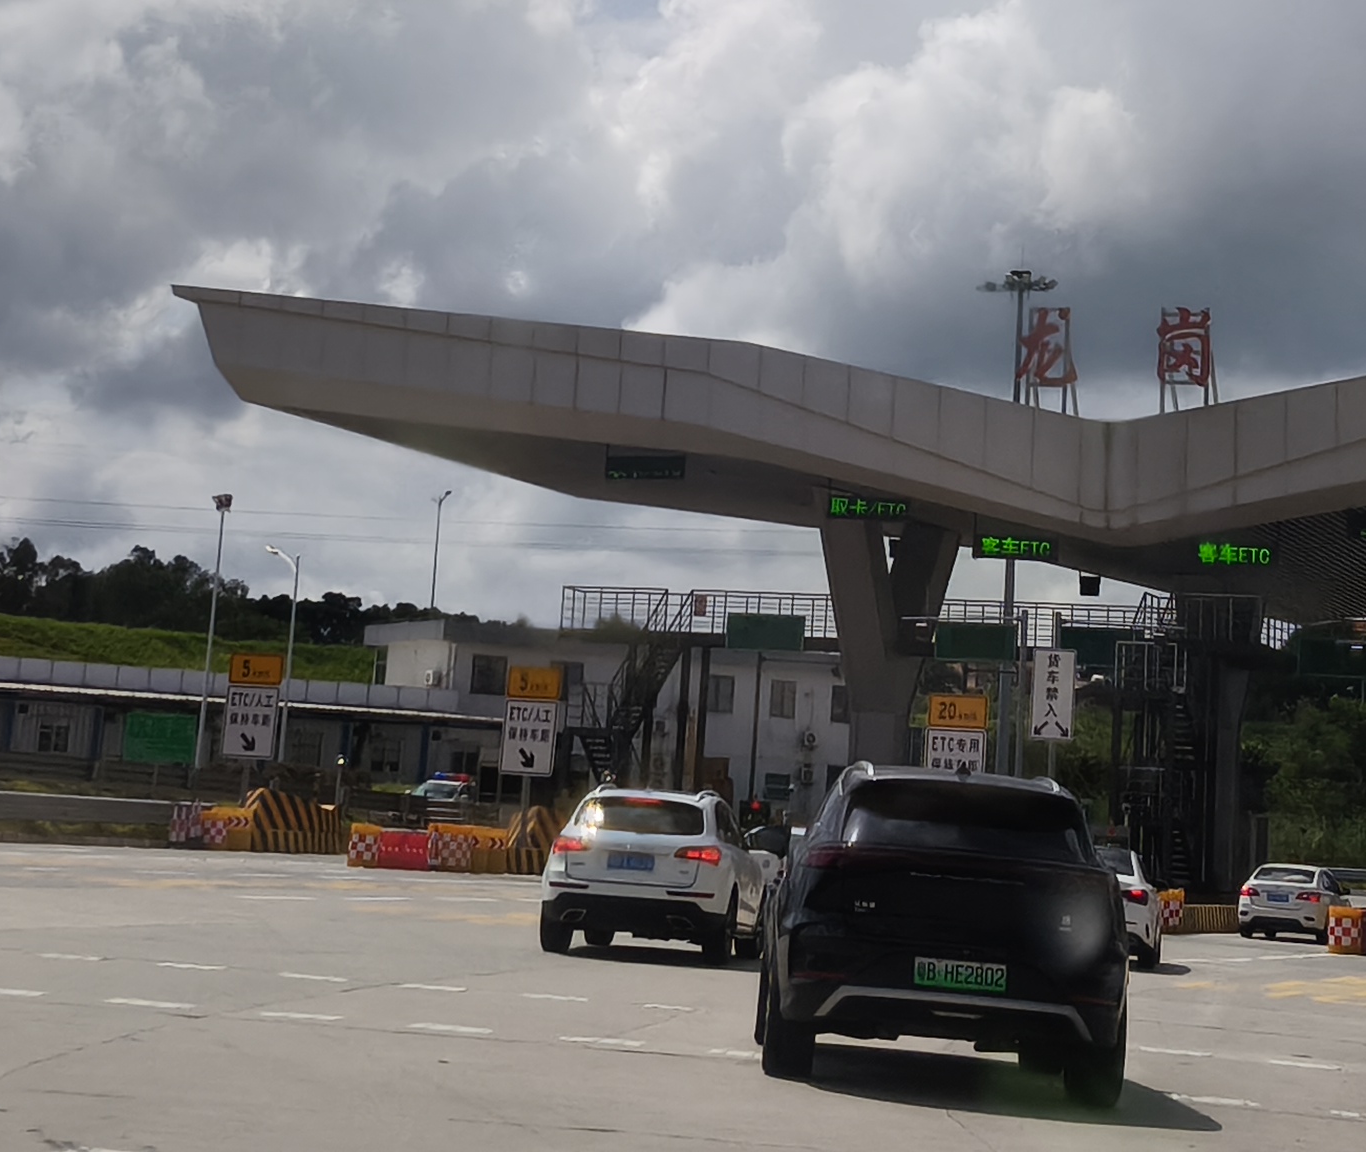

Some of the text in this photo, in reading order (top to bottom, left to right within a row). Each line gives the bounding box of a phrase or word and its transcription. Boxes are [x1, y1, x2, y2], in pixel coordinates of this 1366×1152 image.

[1015, 307, 1211, 387] 龙岗
[242, 659, 251, 678] 5
[1044, 653, 1061, 717] 货车禁入
[230, 692, 274, 708] ETC/人工
[509, 706, 552, 723] ETC/人工
[938, 701, 957, 720] 20
[931, 736, 980, 753] ETC专用
